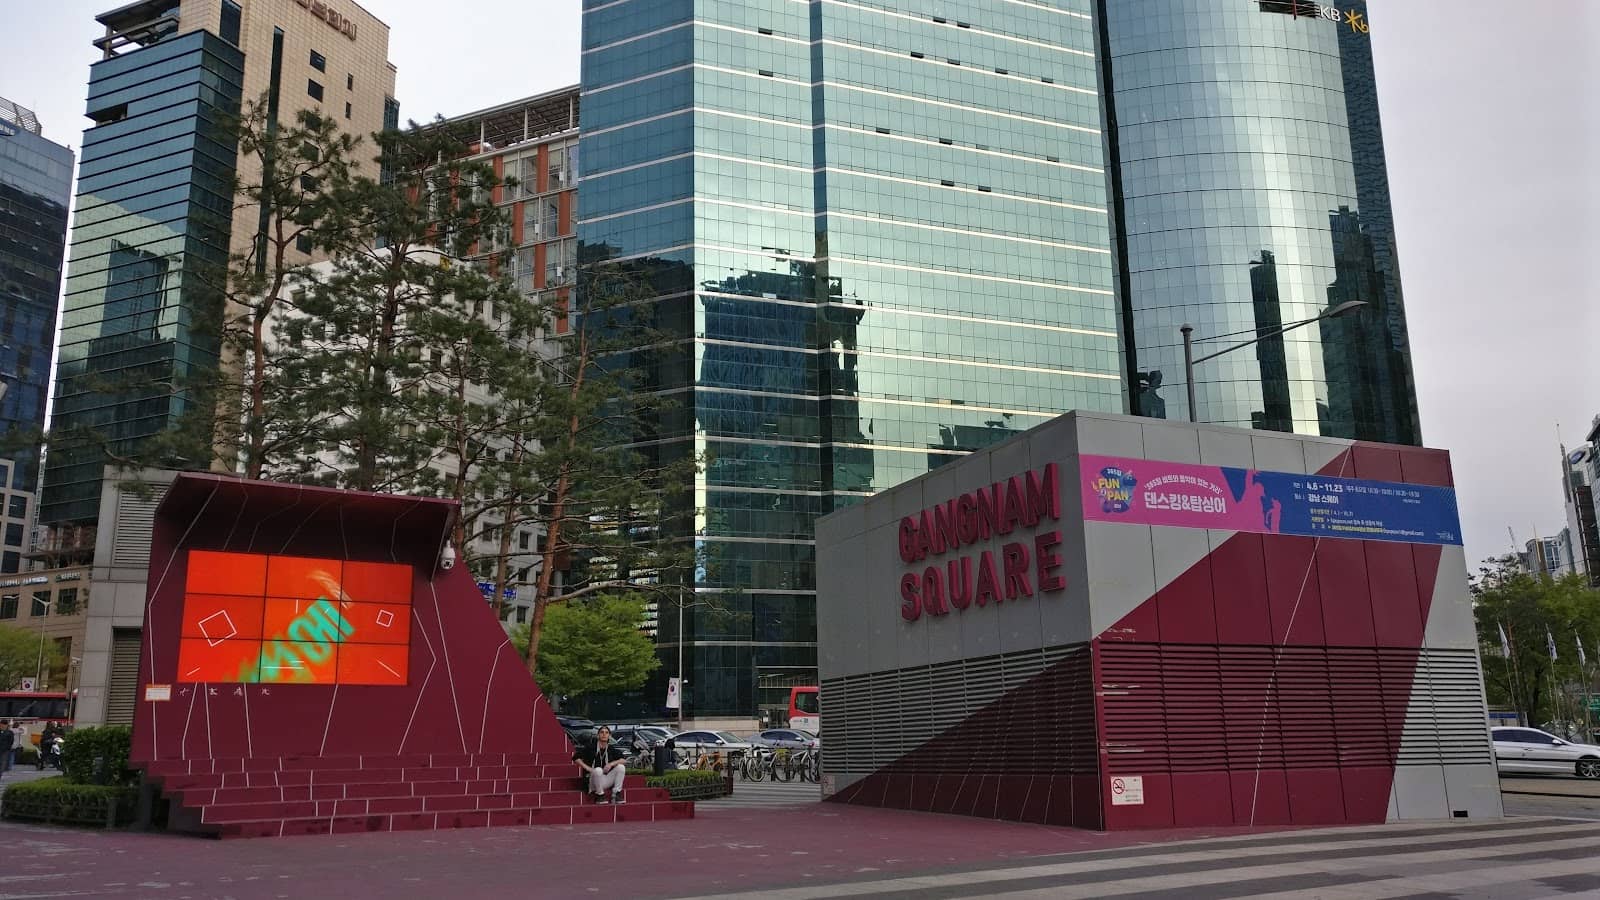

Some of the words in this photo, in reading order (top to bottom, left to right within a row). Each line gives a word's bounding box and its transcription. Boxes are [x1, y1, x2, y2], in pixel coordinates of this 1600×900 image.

[1320, 6, 1341, 22] KB
[1098, 478, 1120, 489] FUN
[1107, 488, 1129, 501] PAN
[1144, 491, 1227, 514] 댄스킹&탑싱어
[898, 462, 1061, 564] GANGNAM
[900, 530, 1066, 622] SQUARE
